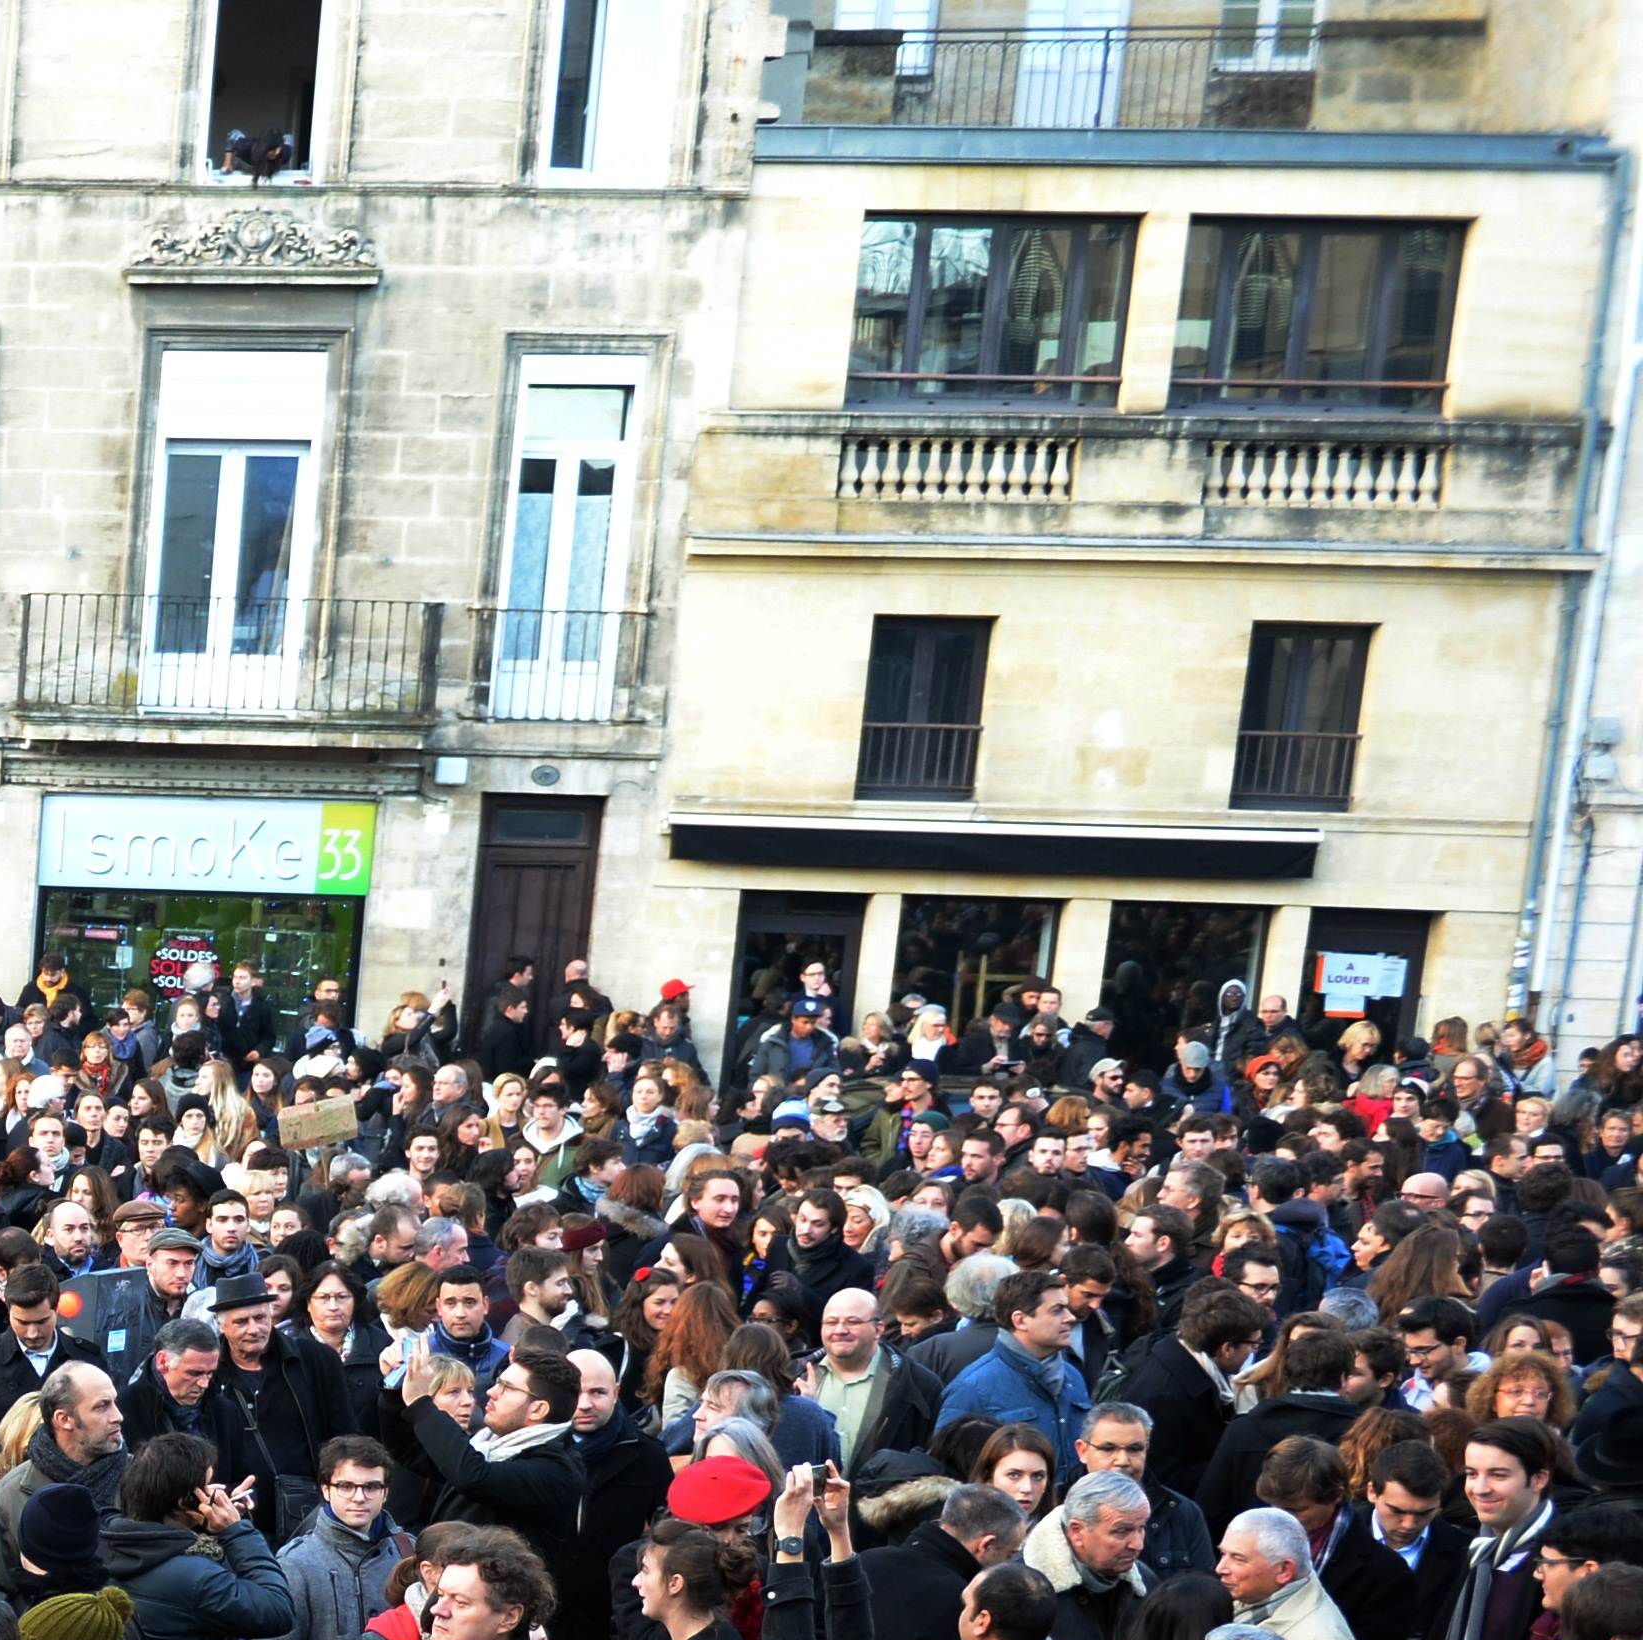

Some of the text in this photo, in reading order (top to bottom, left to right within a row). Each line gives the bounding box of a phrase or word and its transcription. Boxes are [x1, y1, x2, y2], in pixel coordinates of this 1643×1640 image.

[318, 829, 362, 880] 33
[161, 947, 213, 963] SOLDES
[150, 959, 220, 979] SOLS
[157, 975, 184, 989] SOL
[1327, 975, 1370, 985] LOUER
